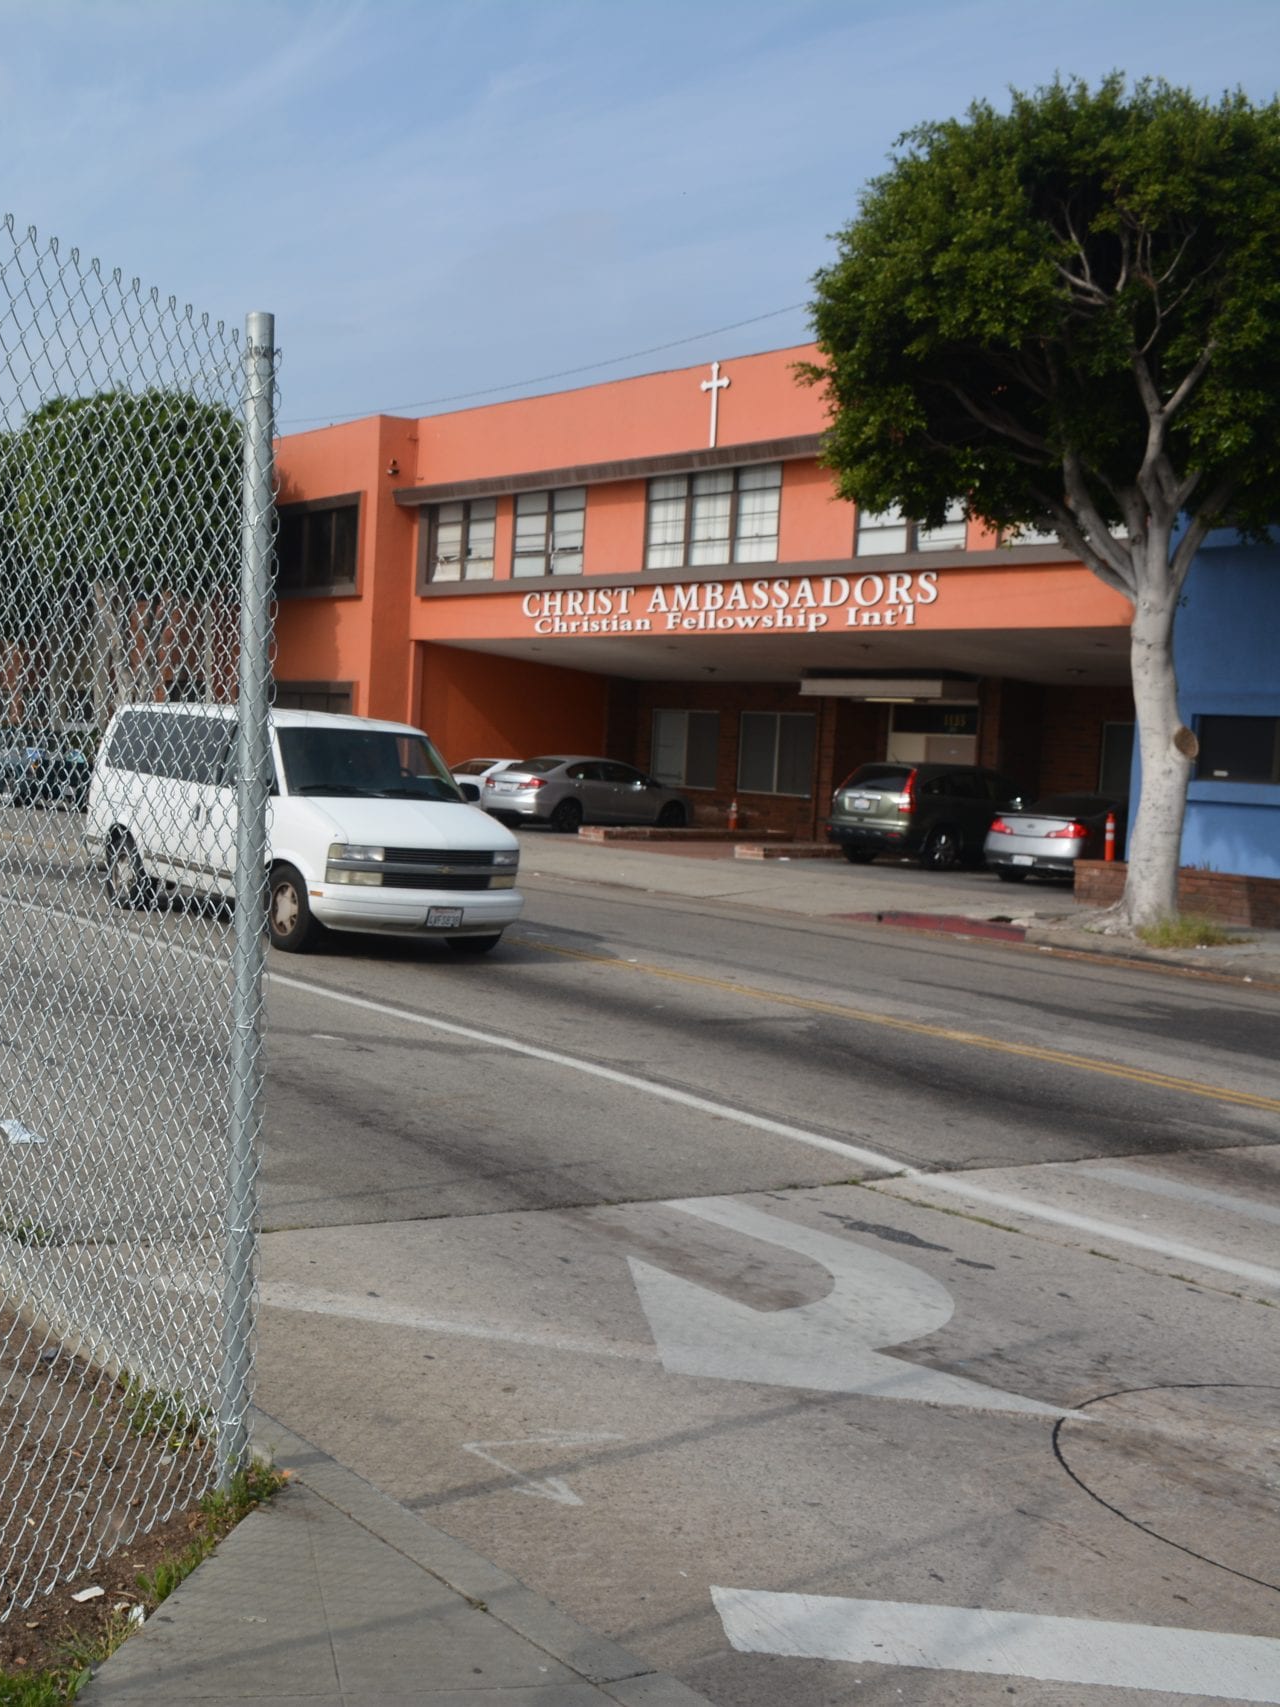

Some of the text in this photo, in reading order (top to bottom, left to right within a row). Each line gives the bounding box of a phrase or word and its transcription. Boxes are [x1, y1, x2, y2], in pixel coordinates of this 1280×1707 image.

[522, 571, 939, 617] CHRIST AMBASSADORS
[534, 604, 915, 634] Christian Fellowship Int'l
